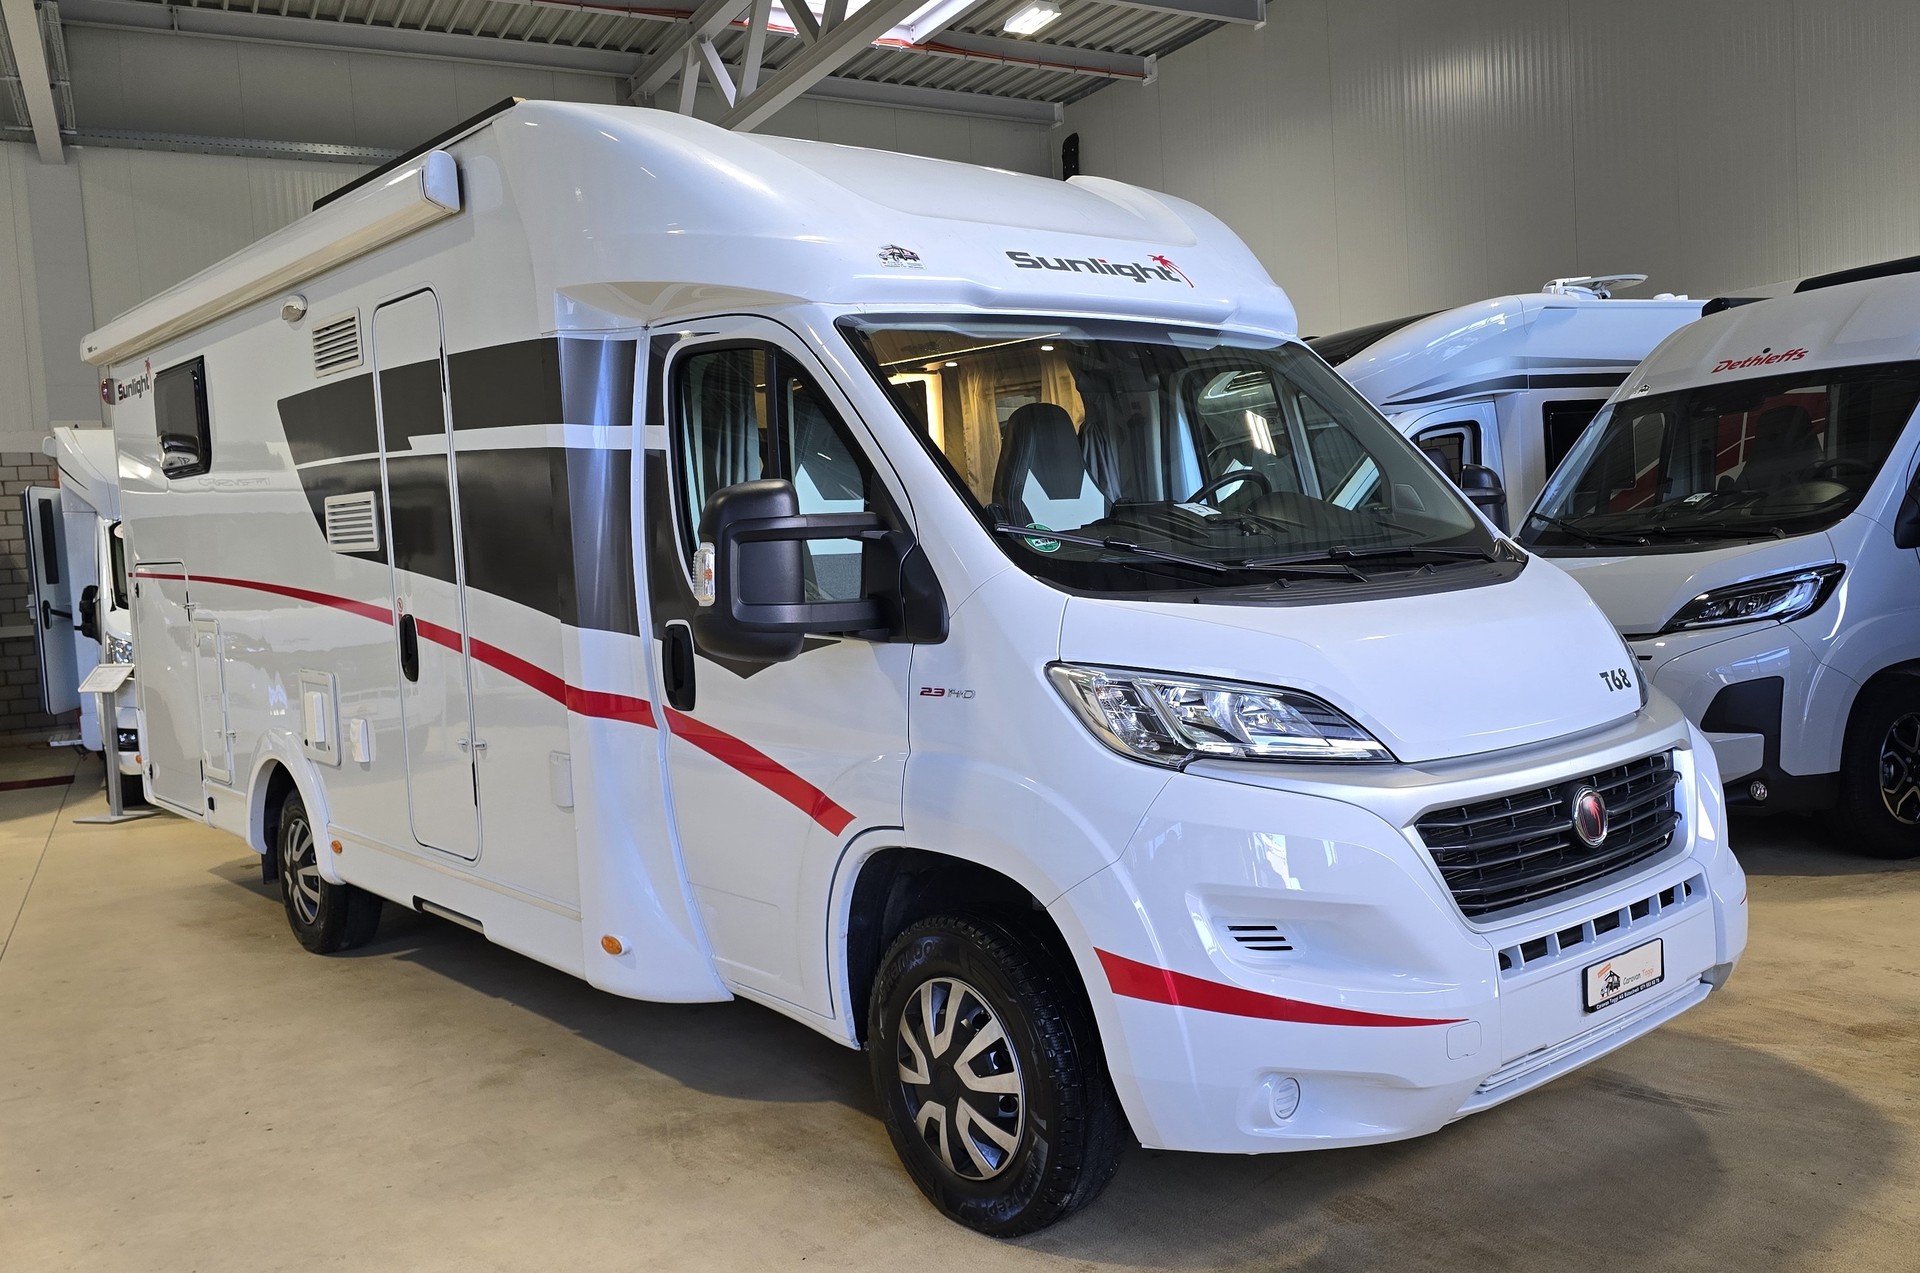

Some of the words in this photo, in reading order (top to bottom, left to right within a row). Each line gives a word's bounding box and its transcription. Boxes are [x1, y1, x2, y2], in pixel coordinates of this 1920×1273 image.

[1005, 251, 1181, 283] Sunlight
[1711, 348, 1809, 373] Dethleffs
[118, 374, 149, 401] Sunlight
[1599, 667, 1632, 692] T68
[1623, 973, 1641, 986] Caravan
